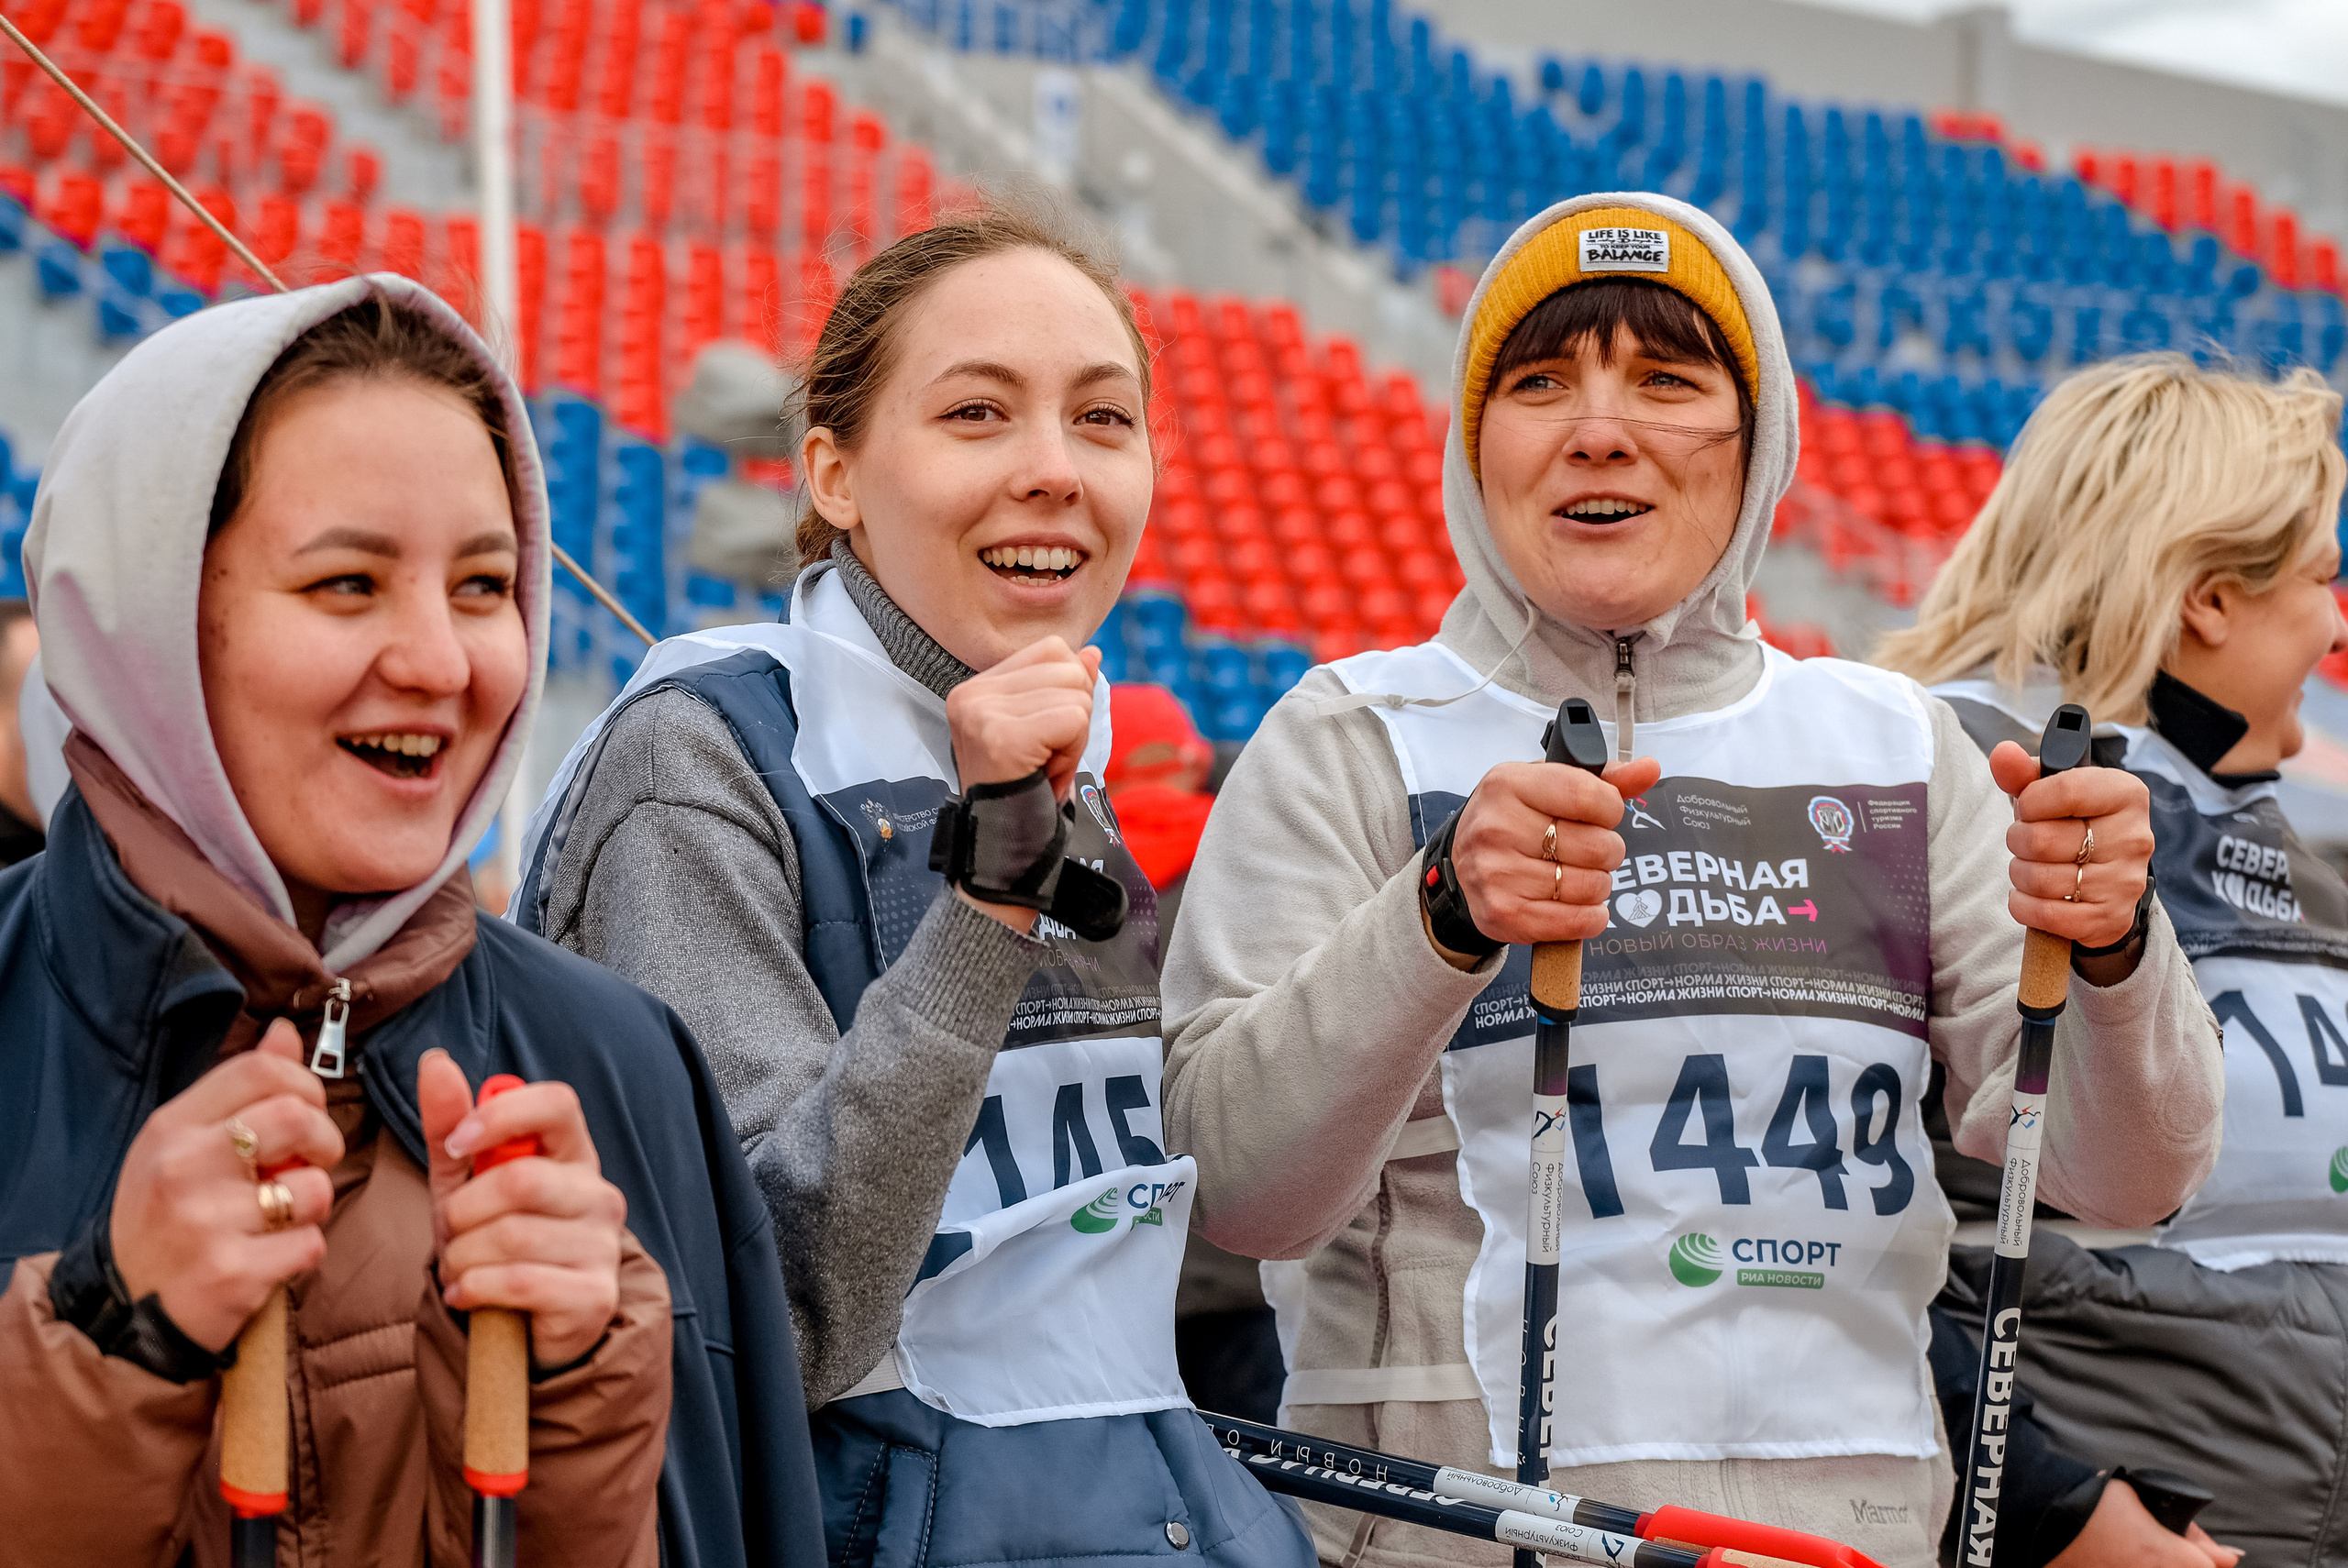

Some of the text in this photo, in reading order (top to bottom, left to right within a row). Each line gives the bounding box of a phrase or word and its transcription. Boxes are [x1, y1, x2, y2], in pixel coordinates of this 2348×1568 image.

[1589, 229, 1661, 240] LIFE IS LIKE
[1587, 248, 1664, 261] BALANCE
[1677, 794, 1747, 813] Добровольный
[1679, 805, 1751, 825] Физкультурный
[1682, 816, 1711, 830] Союз
[1871, 815, 1903, 823] туризма
[1611, 851, 1809, 891] ЕВЕРНАЯ
[1589, 931, 1827, 956] НОВЫЙ ОБРАЗ ЖИЗНИ
[1624, 977, 1665, 991] СПОРТ
[1675, 974, 1722, 988] НОРМА
[1724, 974, 1768, 988] ЖИЗНИ
[1770, 976, 1805, 988] СПОРТ
[1813, 977, 1855, 992] НОРМА
[1855, 983, 1892, 1001] ЖИЗНИ
[1892, 991, 1922, 1007] СПОРТ
[1015, 999, 1046, 1015] СПОРТ
[1474, 997, 1513, 1015] СПОРТ
[1627, 988, 1676, 1004] НОРМА
[1677, 986, 1725, 1000] ЖИЗНИ
[1726, 986, 1764, 999] СПОРТ
[1773, 988, 1814, 1001] НОРМА
[1816, 990, 1857, 1006] ЖИЗНИ
[1858, 995, 1888, 1011] СПОРТ
[1893, 1002, 1925, 1022] НОРМА
[1016, 1011, 1052, 1031] НОРМА
[1475, 1008, 1524, 1029] НОРМА
[2209, 989, 2348, 1118] 14
[1567, 1054, 1914, 1219] 1449
[1531, 1161, 1541, 1195] Союз
[1541, 1163, 1555, 1253] Физкультурный
[2000, 1157, 2018, 1244] Физкультурный
[2013, 1159, 2031, 1246] Добровольный
[1733, 1238, 1842, 1266] СПОРТ
[1741, 1272, 1822, 1286] РИА НОВОСТИ
[1966, 1308, 2021, 1568] СЕВЕРНАЯ
[1270, 1438, 1388, 1482] НОВЫЙ
[1446, 1471, 1523, 1496] Добровольный
[1505, 1527, 1578, 1552] Физкультурный
[1555, 1524, 1584, 1538] Союз
